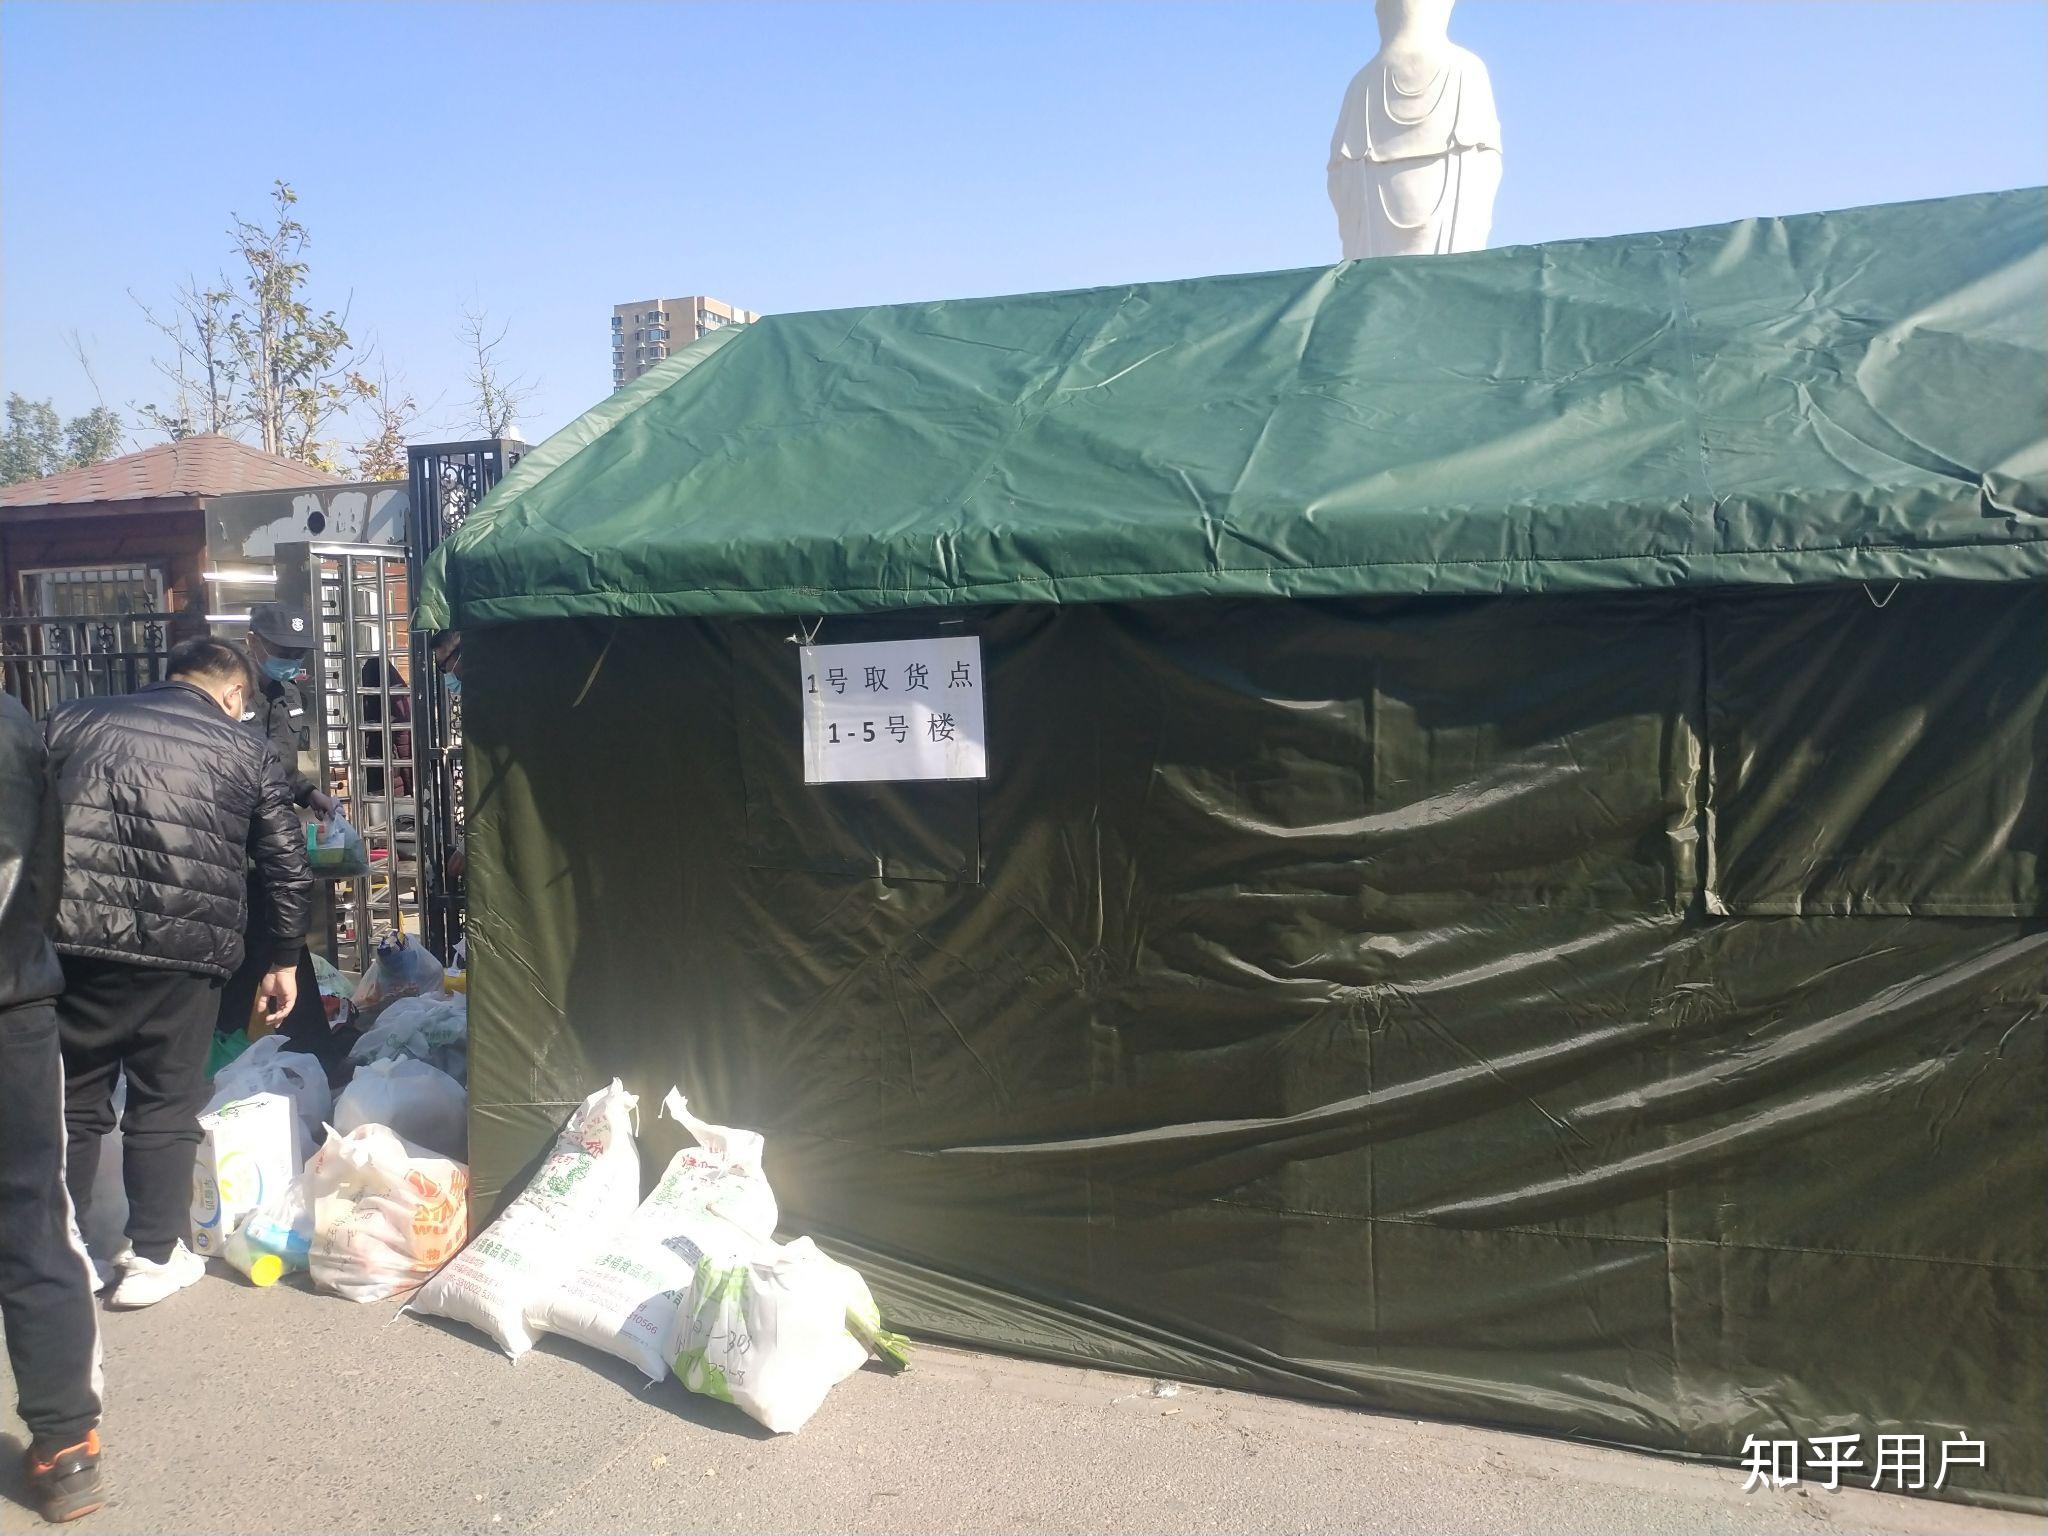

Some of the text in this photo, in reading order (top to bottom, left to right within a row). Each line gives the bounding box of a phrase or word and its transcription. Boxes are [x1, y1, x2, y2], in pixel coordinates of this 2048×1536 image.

[807, 661, 973, 694] 1号取货点
[828, 713, 955, 744] 1-5号楼
